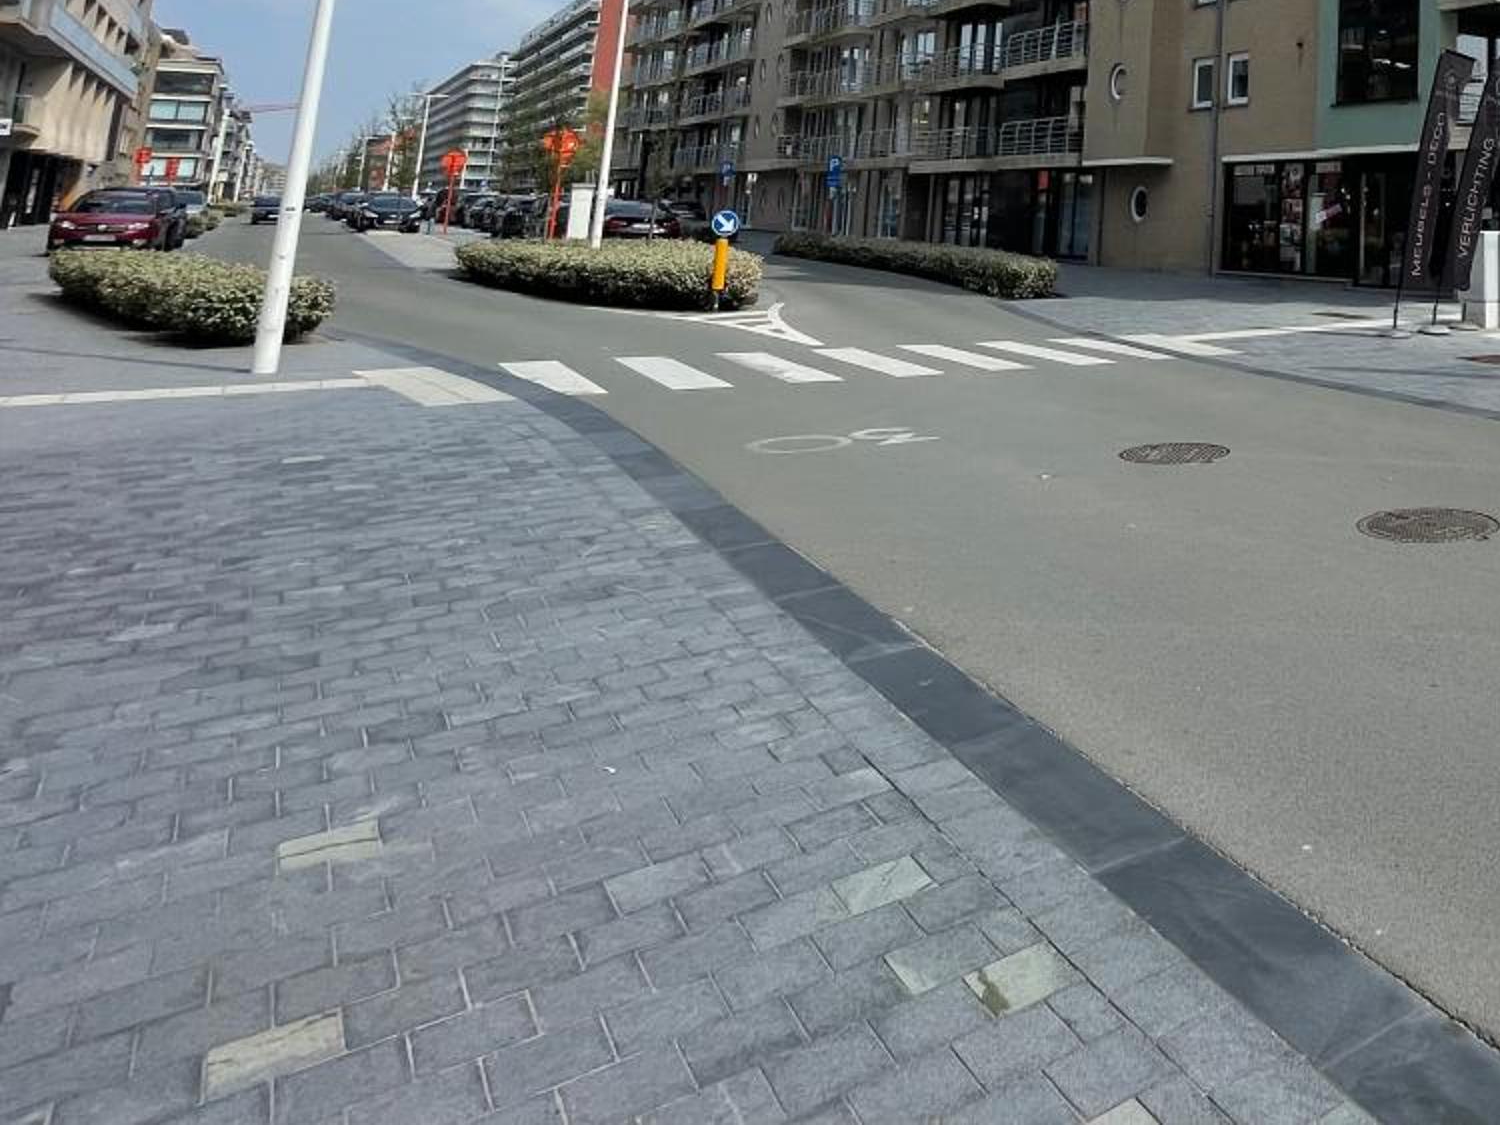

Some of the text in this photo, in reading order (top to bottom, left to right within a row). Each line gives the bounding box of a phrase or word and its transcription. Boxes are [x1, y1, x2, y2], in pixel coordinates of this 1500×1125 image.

[1411, 184, 1432, 277] MEUBELS
[1427, 111, 1445, 165] DECO
[1457, 137, 1496, 259] VERLICHTING
